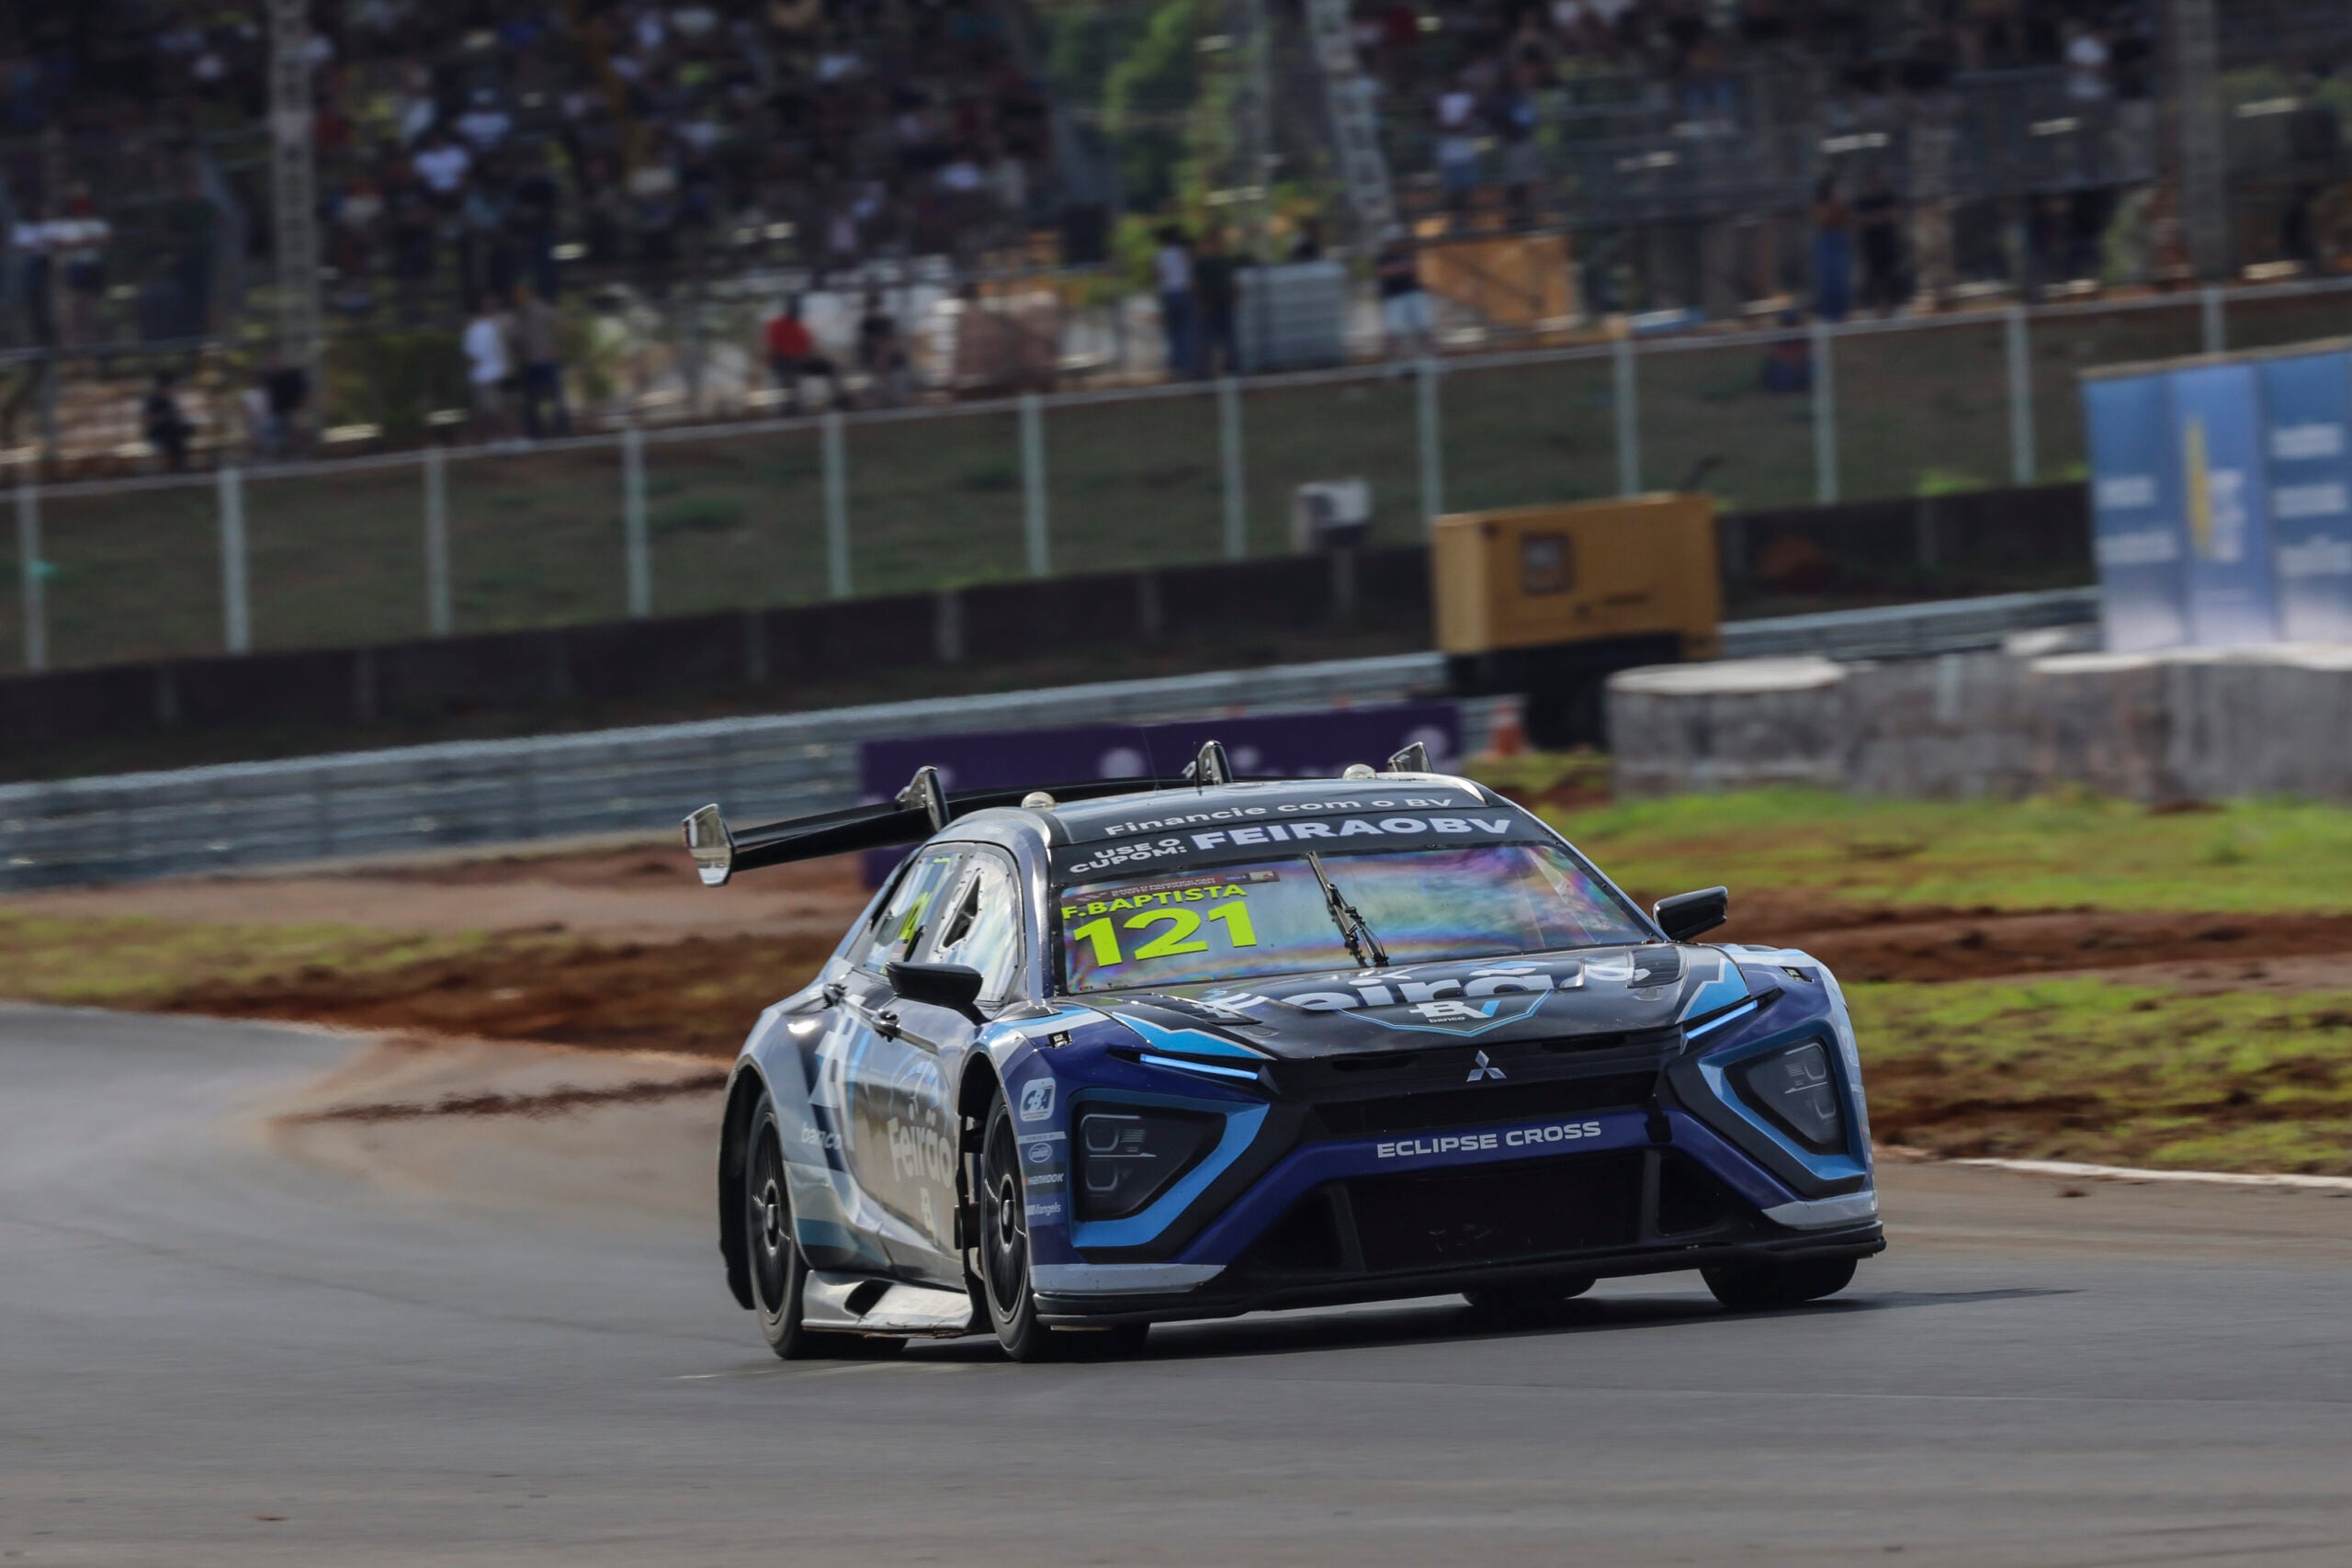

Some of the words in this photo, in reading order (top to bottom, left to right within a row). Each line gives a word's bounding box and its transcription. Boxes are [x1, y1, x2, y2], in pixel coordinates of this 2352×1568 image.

[1104, 807, 1266, 835] Financie
[1277, 800, 1361, 812] com
[1406, 798, 1452, 807] BV
[1094, 842, 1150, 859] USE
[1158, 839, 1181, 847] O
[1191, 818, 1510, 851] FEIRAOBV
[1069, 846, 1187, 873] CUPOM:
[1060, 884, 1248, 919] F.BAPTISTA
[1073, 900, 1257, 967] 121
[1429, 1015, 1466, 1023] banco
[800, 1121, 842, 1150] banco
[887, 1103, 954, 1189] Feirão
[1377, 1133, 1498, 1158] ECLIPSE
[1506, 1122, 1602, 1145] CROSS
